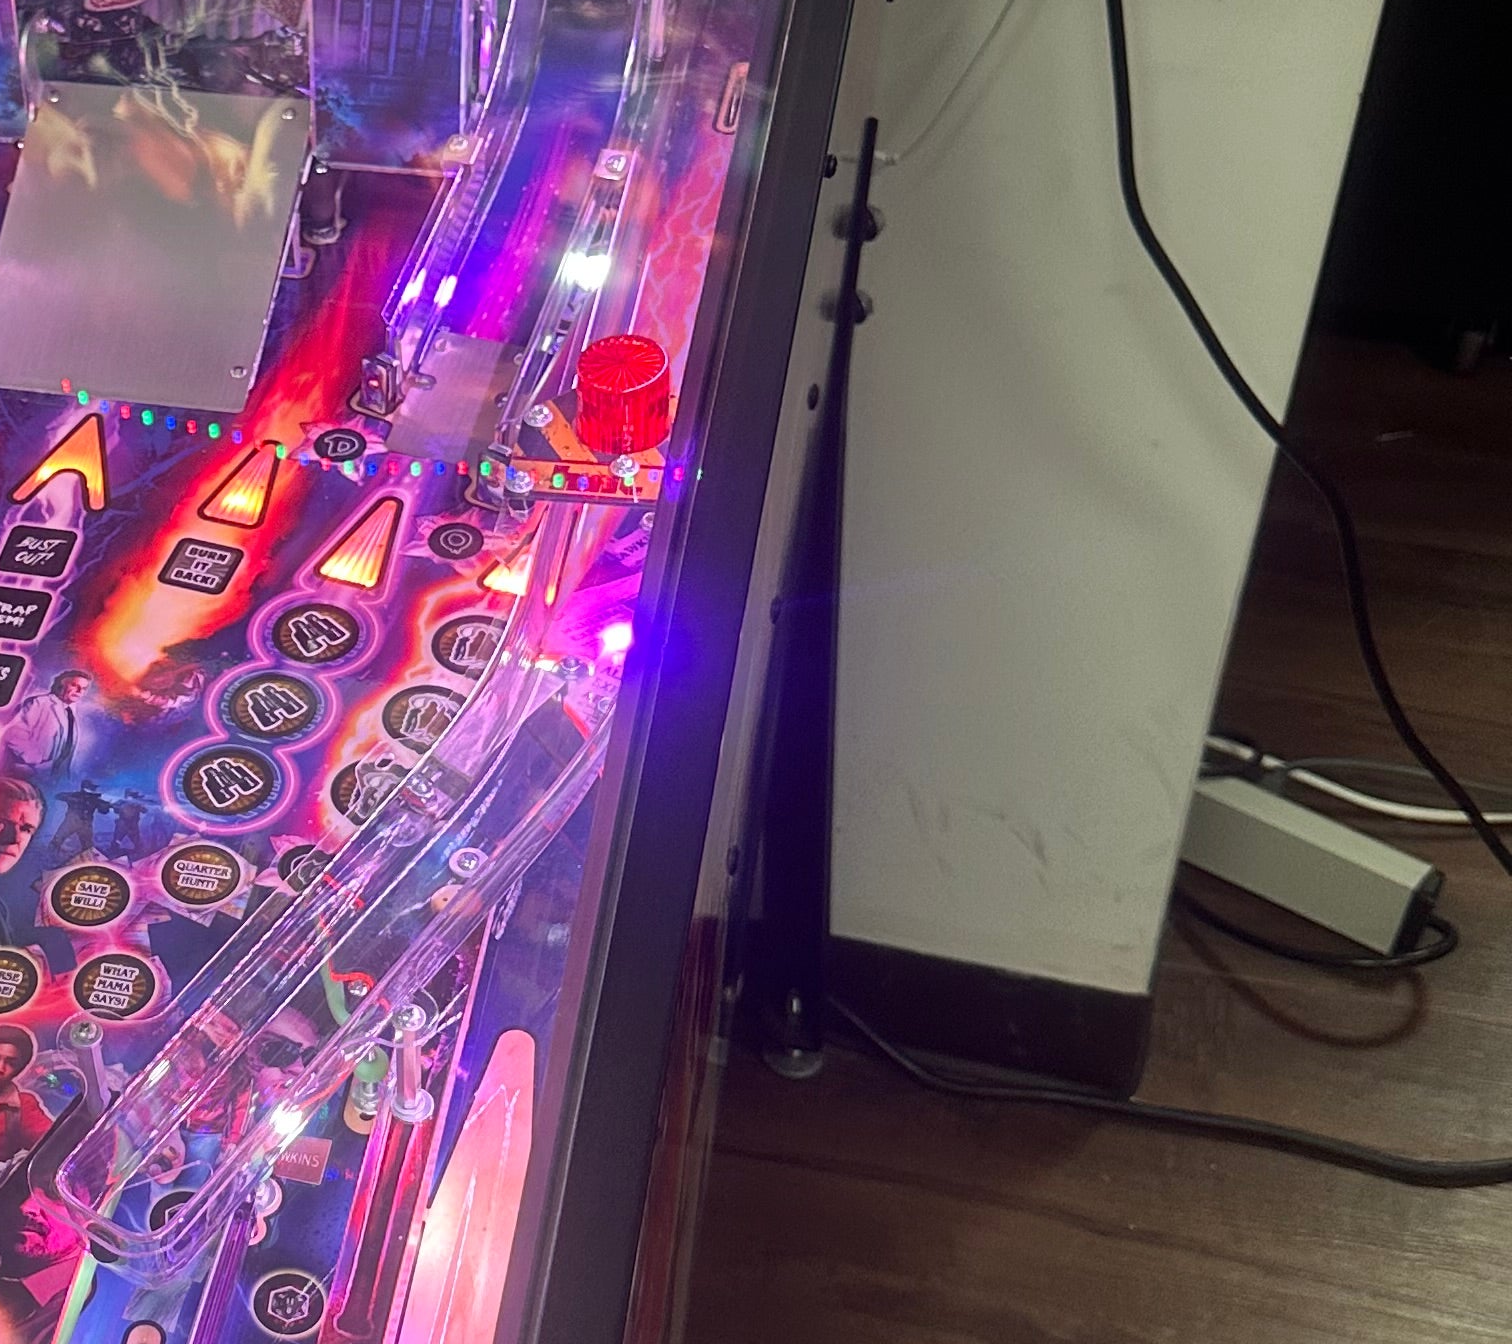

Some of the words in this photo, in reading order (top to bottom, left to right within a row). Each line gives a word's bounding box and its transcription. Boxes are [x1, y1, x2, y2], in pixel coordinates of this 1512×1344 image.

[16, 536, 67, 549] BUST
[15, 551, 55, 566] OUT!
[186, 545, 231, 564] BURN
[191, 559, 212, 573] IT
[171, 568, 219, 588] BACK!
[175, 861, 231, 877] QUARTER
[76, 881, 110, 895] SAVE
[179, 875, 218, 889] HUNT!
[71, 895, 105, 909] WILL!
[100, 964, 139, 979] WHAT
[94, 979, 133, 994] MAMA
[88, 993, 128, 1008] SAYS!
